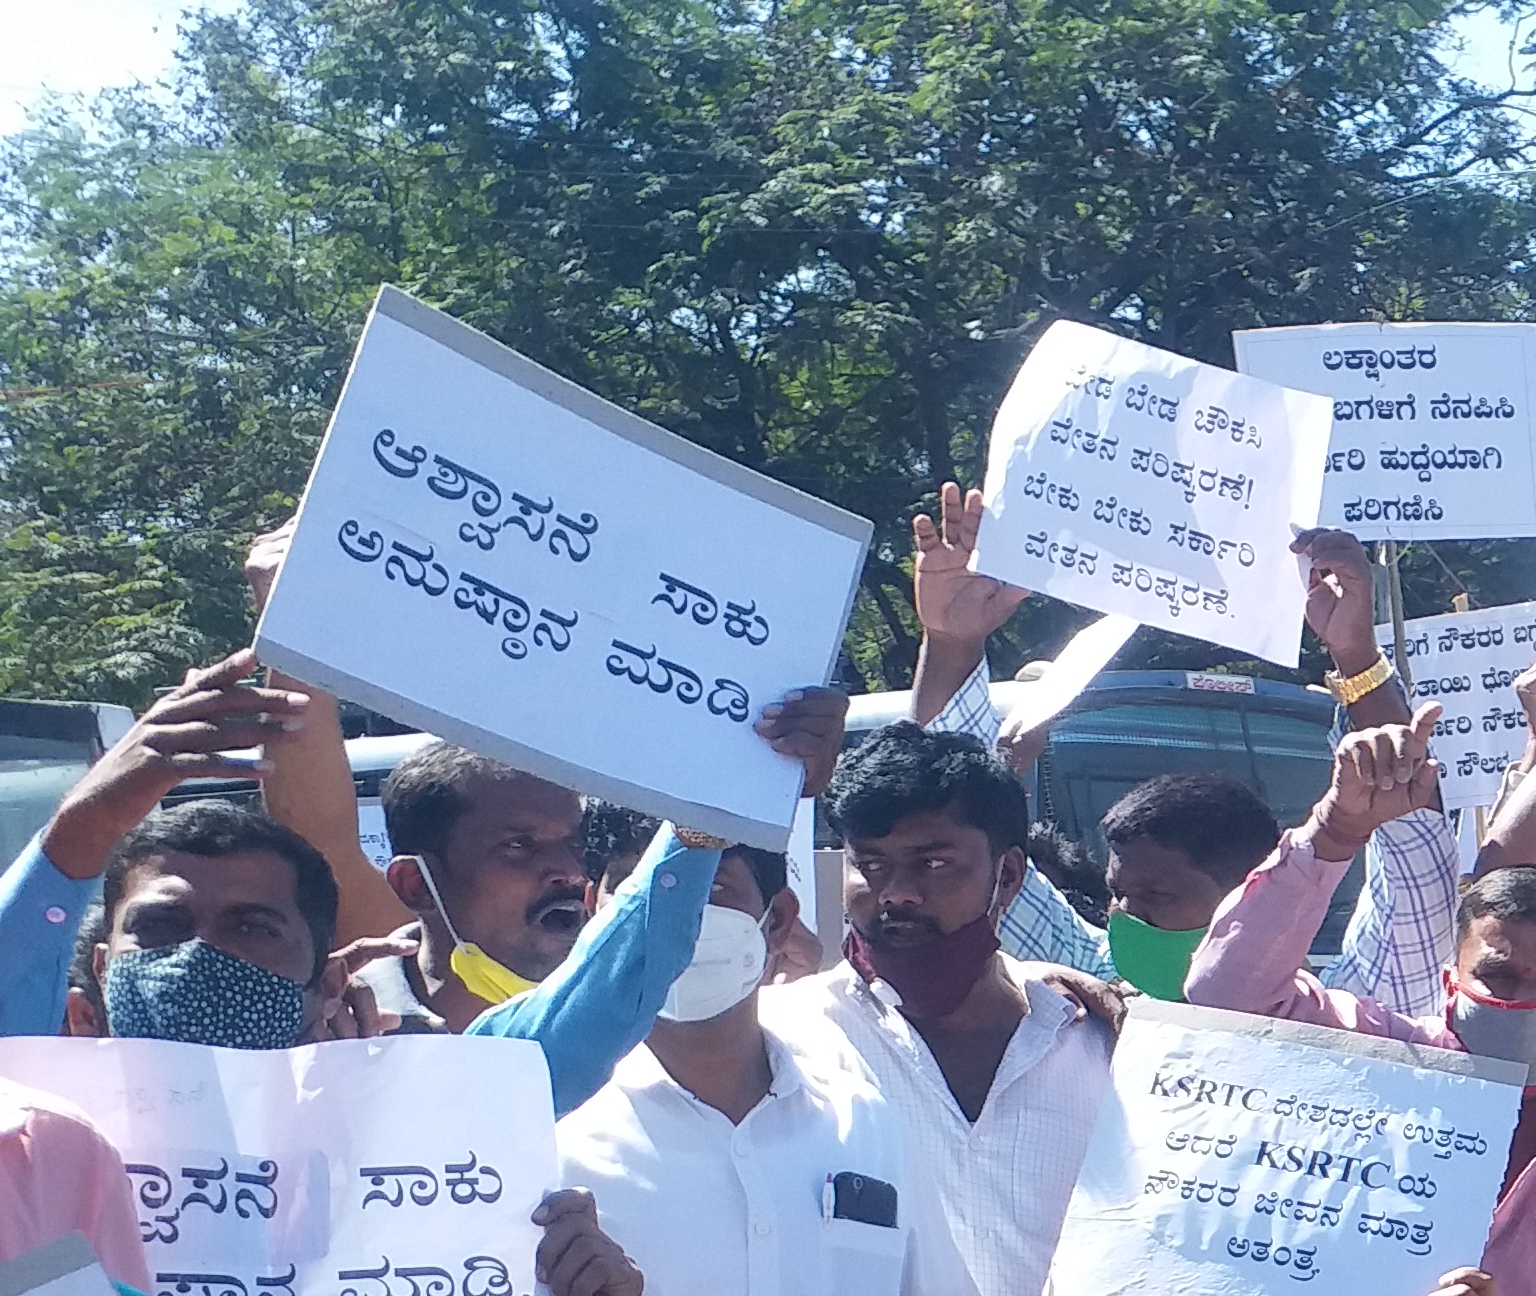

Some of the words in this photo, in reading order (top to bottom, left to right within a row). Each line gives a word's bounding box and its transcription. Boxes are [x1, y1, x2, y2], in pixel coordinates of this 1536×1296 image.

[1125, 383, 1180, 423] ಬೇಡ
[1333, 393, 1417, 421] ಬಗಳಿಗೆ
[1430, 392, 1516, 420] ನೆನಪಿಸಿ
[1050, 418, 1120, 461] ವೇತನ
[1131, 447, 1255, 510] ಪರಿಷ್ಕರಣೆ!
[1379, 443, 1503, 483] ಹುದ್ದೆಯಾಗಿ
[373, 428, 599, 562] ಆಶ್ವಾಸನೆ
[651, 572, 769, 646] ಸಾಕು
[1023, 472, 1081, 512] ಬೇಕು
[1093, 497, 1153, 536] ಬೇಕು
[1168, 521, 1257, 567] ಸರ್ಕಾರಿ
[1343, 495, 1444, 522] ಪರಿಗಣಿಸಿ
[1025, 531, 1099, 576] ವೇತನ
[1111, 562, 1236, 619] ಪರಿಷ್ಕರಣೆ.
[338, 520, 578, 660] ಅನುಷ್ಠಾನ
[606, 639, 750, 723] ಮಾಡಿ
[1437, 623, 1504, 653] ನೌಕರರ
[1150, 1071, 1268, 1112] KSRTC
[1403, 1119, 1488, 1160] ಉತ್ತಮ
[359, 1150, 502, 1210] ಸಾಕು
[1165, 1130, 1238, 1159] ಆದರೆ
[1254, 1140, 1391, 1190] KSRTC
[1398, 1172, 1438, 1199] ಯ
[1144, 1169, 1241, 1207] ನೌಕರರ
[1254, 1191, 1344, 1228] ಜೀವನ
[1358, 1211, 1434, 1256] ಮಾತ್ರ
